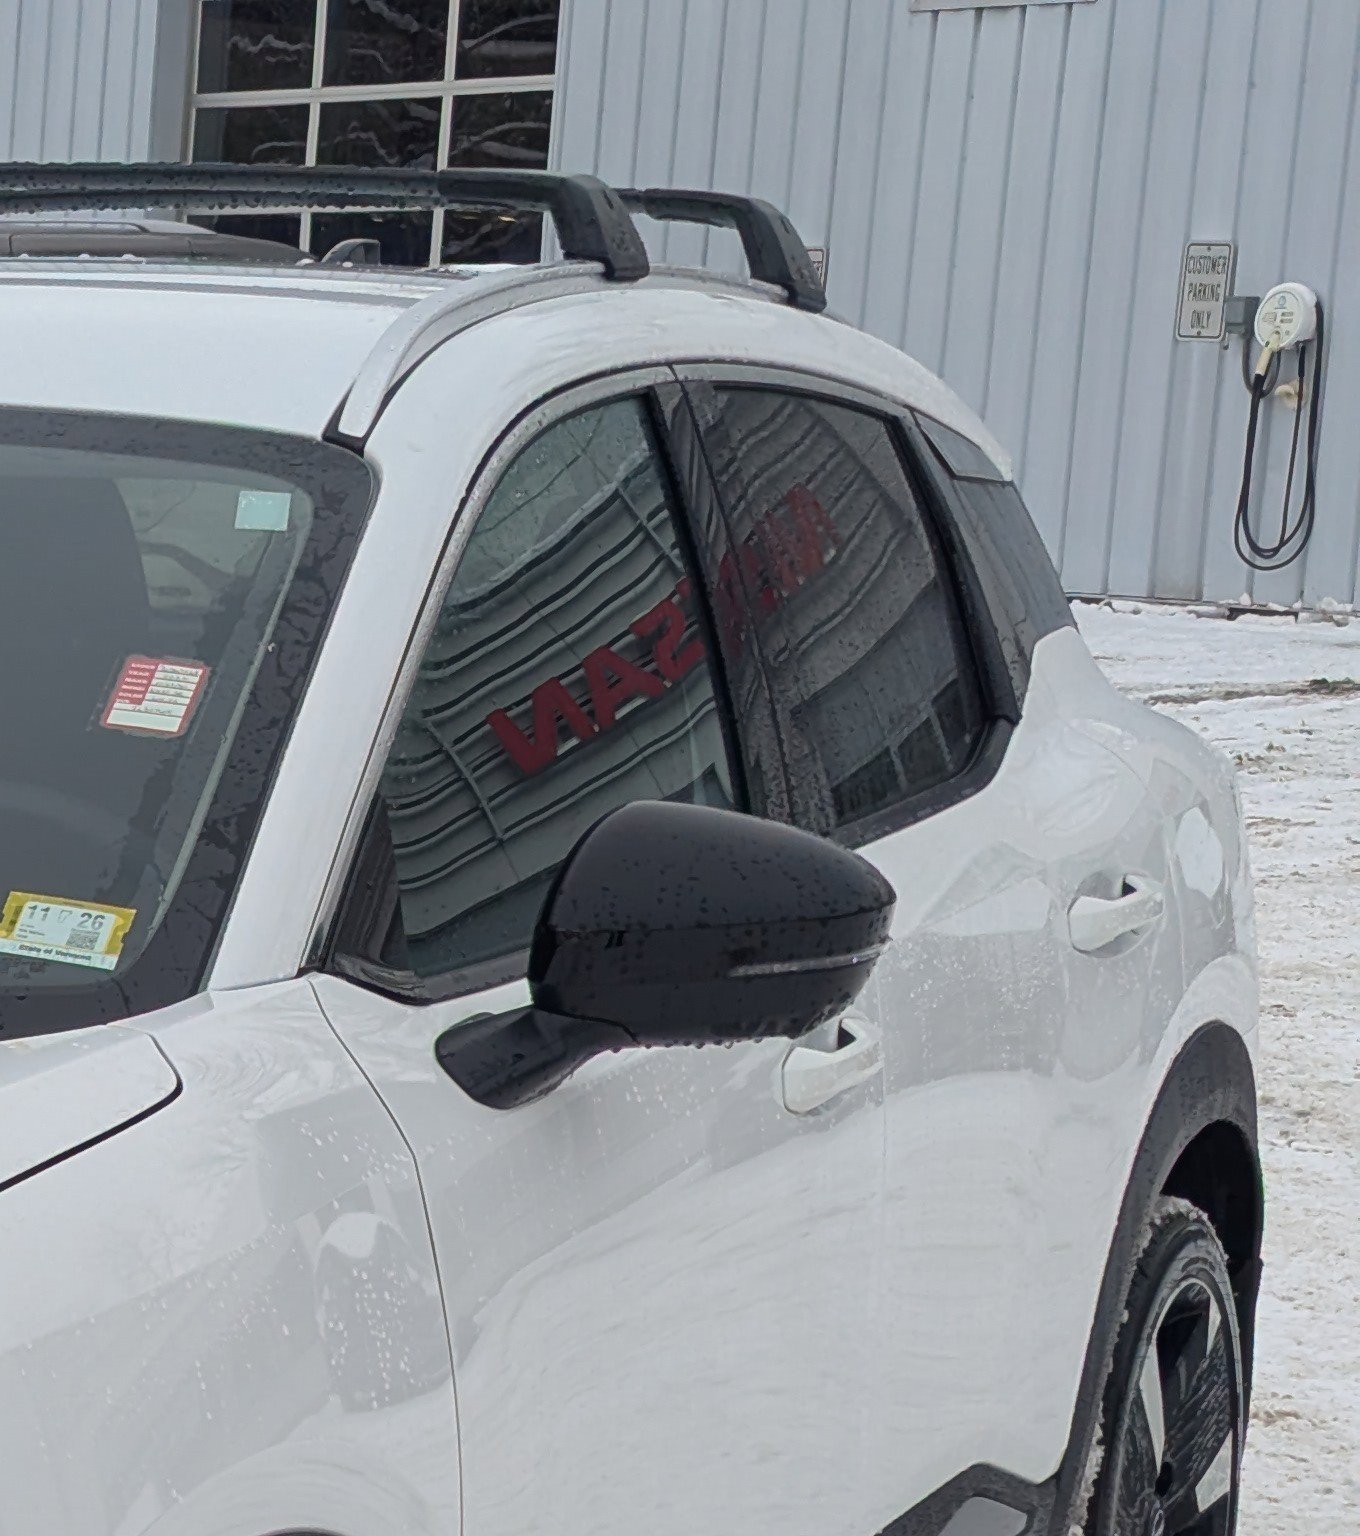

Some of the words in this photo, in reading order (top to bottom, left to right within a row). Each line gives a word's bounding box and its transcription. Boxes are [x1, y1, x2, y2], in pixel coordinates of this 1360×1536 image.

[1187, 255, 1228, 274] CUSTOMER
[1187, 283, 1221, 301] PARKING
[1191, 309, 1212, 329] ONLY
[27, 904, 51, 922] 11
[77, 912, 106, 930] 26
